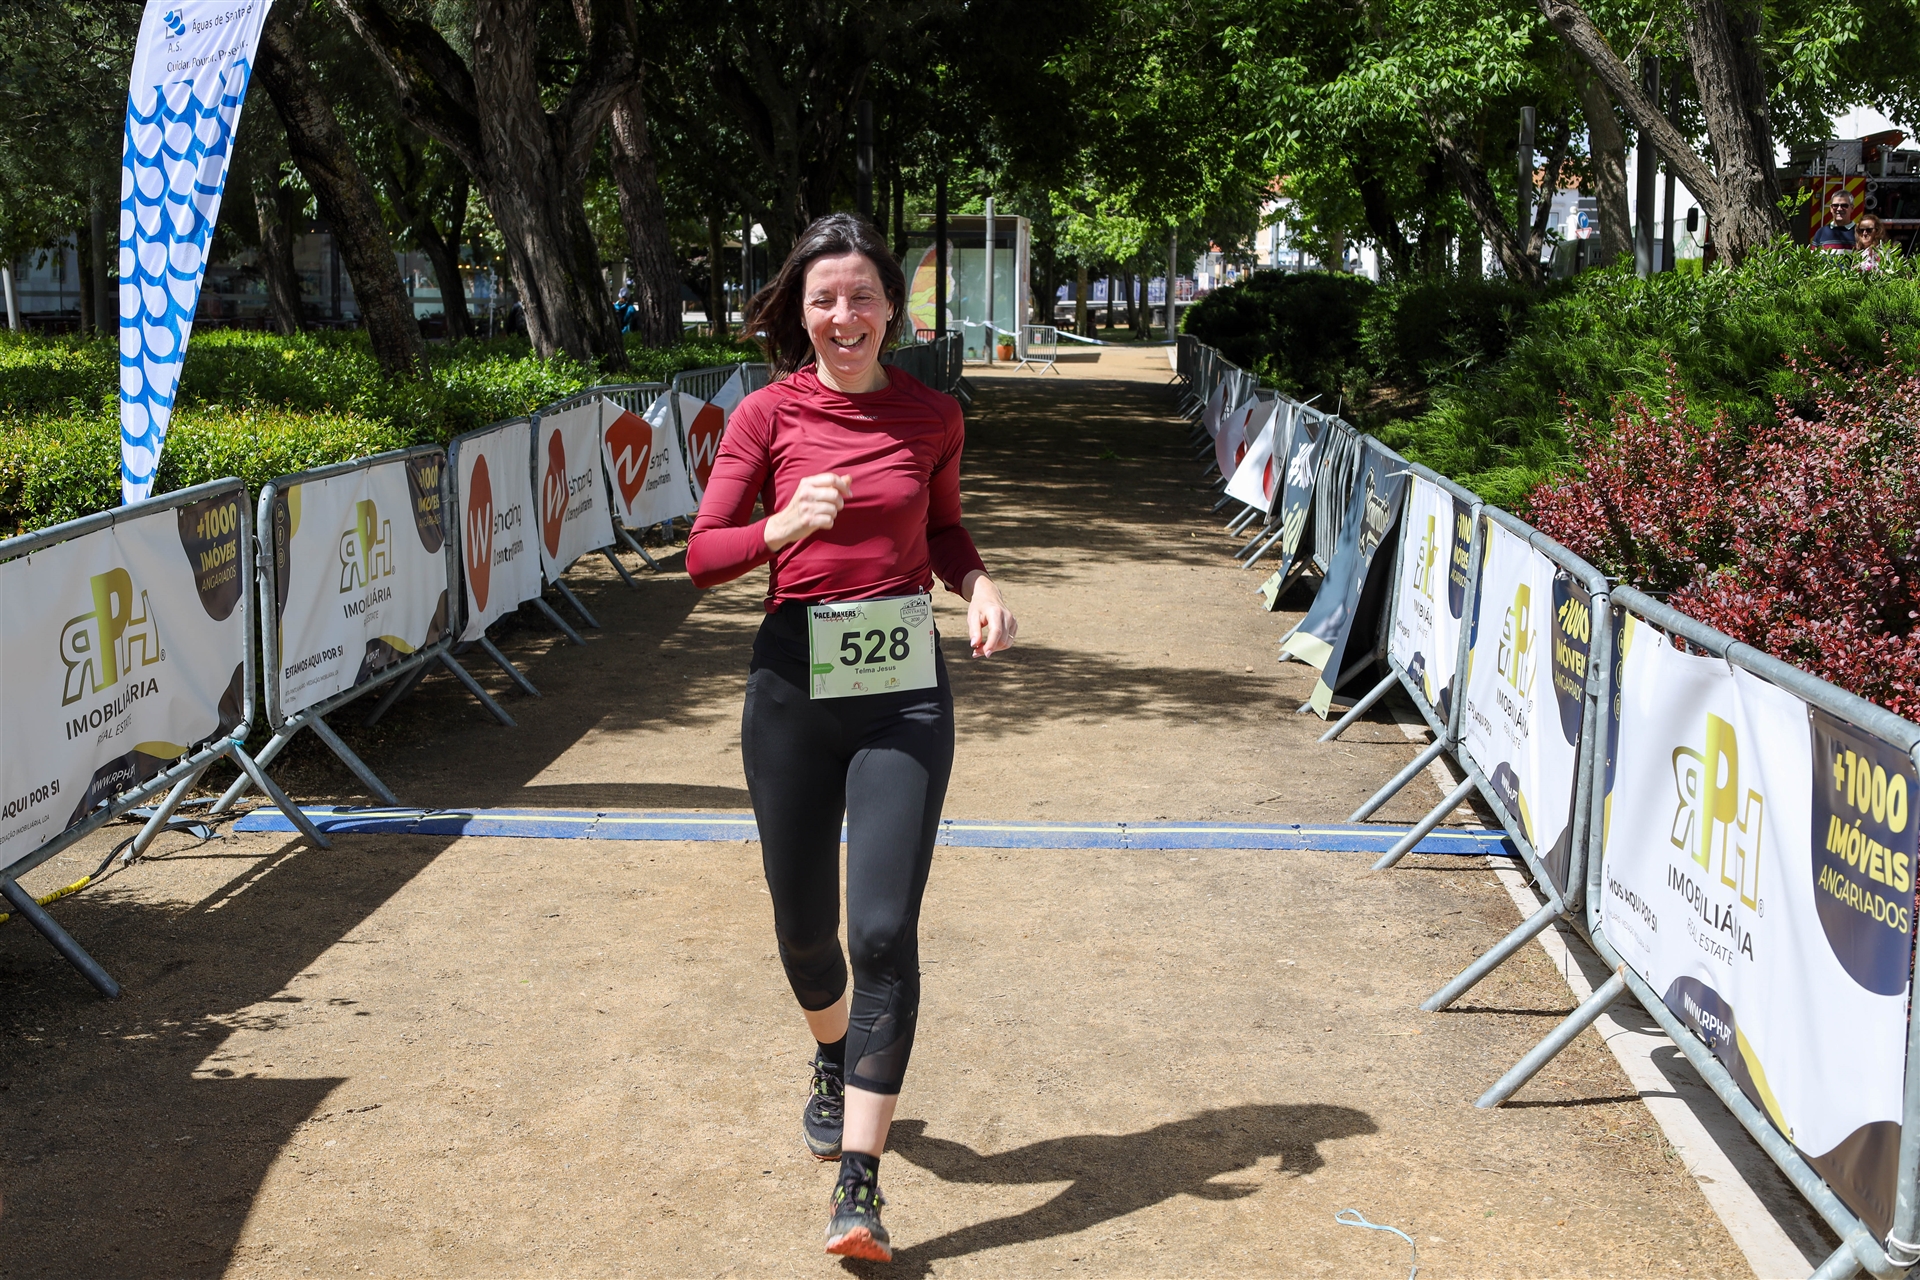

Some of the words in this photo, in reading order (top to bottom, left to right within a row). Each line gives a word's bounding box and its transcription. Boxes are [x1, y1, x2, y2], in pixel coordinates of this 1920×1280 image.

[214, 14, 224, 27] de
[197, 502, 237, 541] +1000
[200, 539, 237, 573] IMÓVEIS
[201, 565, 237, 593] ANGARIADOS
[322, 647, 338, 663] POR
[337, 644, 344, 657] SI
[839, 626, 910, 667] 528
[855, 667, 876, 675] Telma
[876, 665, 897, 674] Jesus
[66, 677, 159, 741] IMOBILIÁRIA
[1, 795, 28, 820] AQUI
[30, 784, 50, 807] POR
[50, 779, 60, 796] SI
[1832, 749, 1909, 834] +1000
[1826, 814, 1911, 893] IMÓVEIS
[1624, 888, 1642, 914] AQUI
[1640, 900, 1652, 928] POR
[1651, 912, 1658, 934] SI
[1817, 864, 1910, 935] ANGARIADOS
[1698, 931, 1735, 968] ESTATE
[1683, 991, 1733, 1046] WWW.RPH.PT
